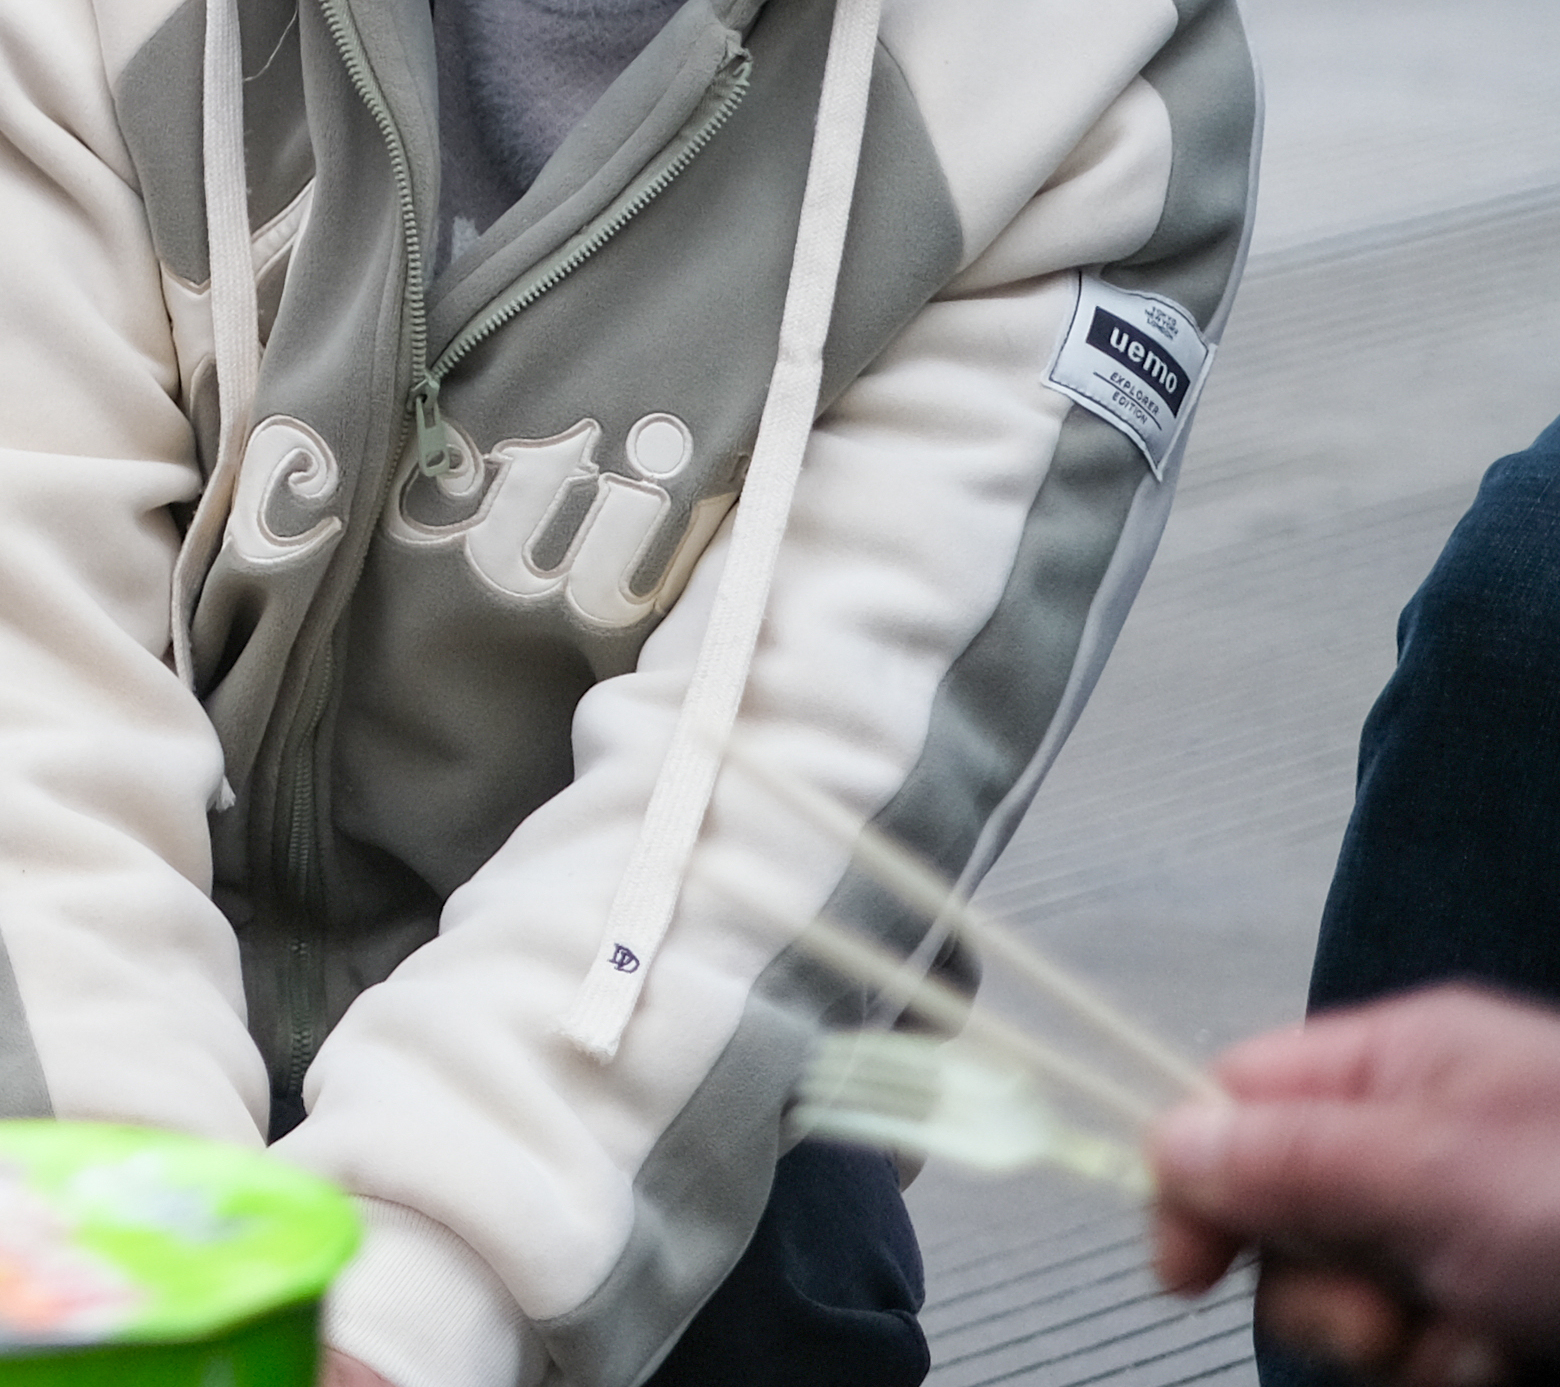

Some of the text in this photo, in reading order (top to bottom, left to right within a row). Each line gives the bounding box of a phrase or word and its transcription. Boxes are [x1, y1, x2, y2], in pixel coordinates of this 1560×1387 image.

[1109, 326, 1178, 394] uemo
[1109, 371, 1160, 416] EXPLORER
[1111, 391, 1148, 425] EDITION
